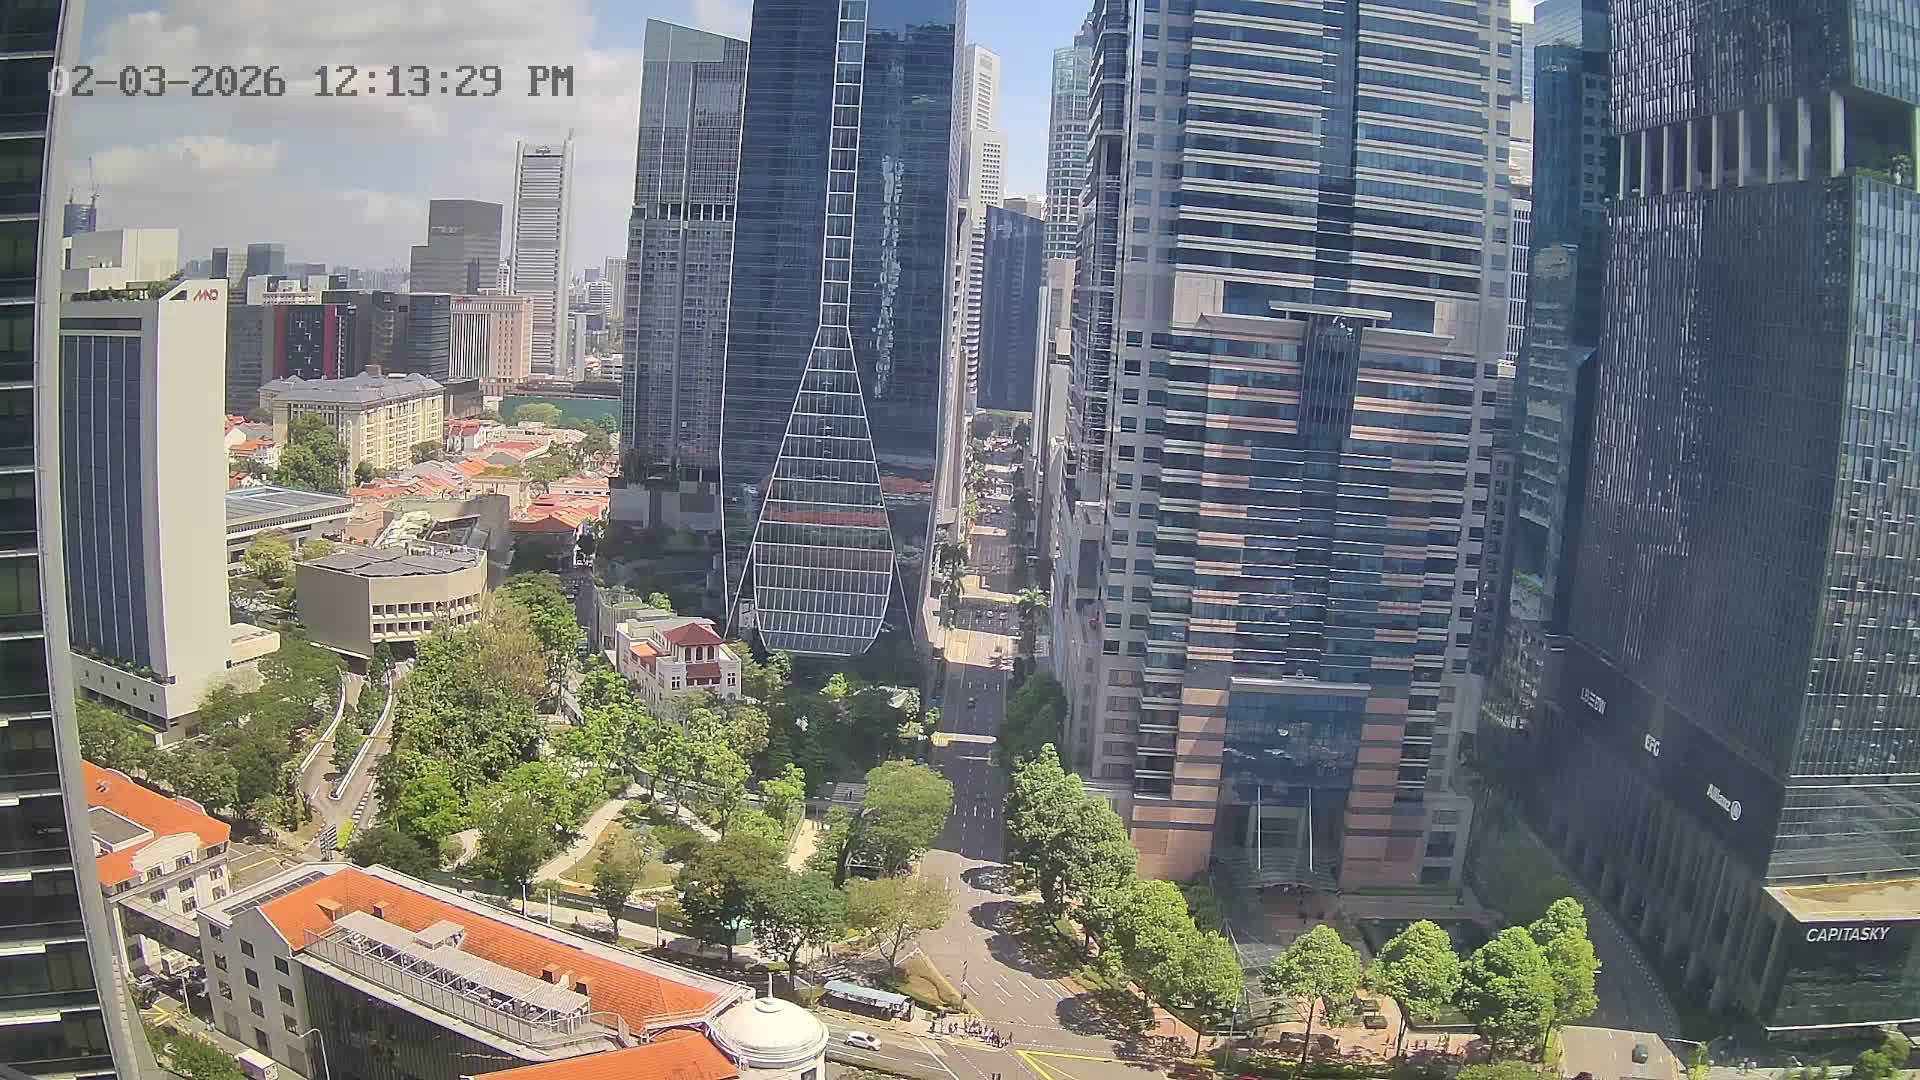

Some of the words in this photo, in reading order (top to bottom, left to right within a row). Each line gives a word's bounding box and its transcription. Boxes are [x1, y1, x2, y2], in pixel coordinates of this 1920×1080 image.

[1644, 732, 1661, 757] EFG
[1706, 783, 1731, 812] Allianz
[1806, 927, 1890, 942] CAPITASKY
